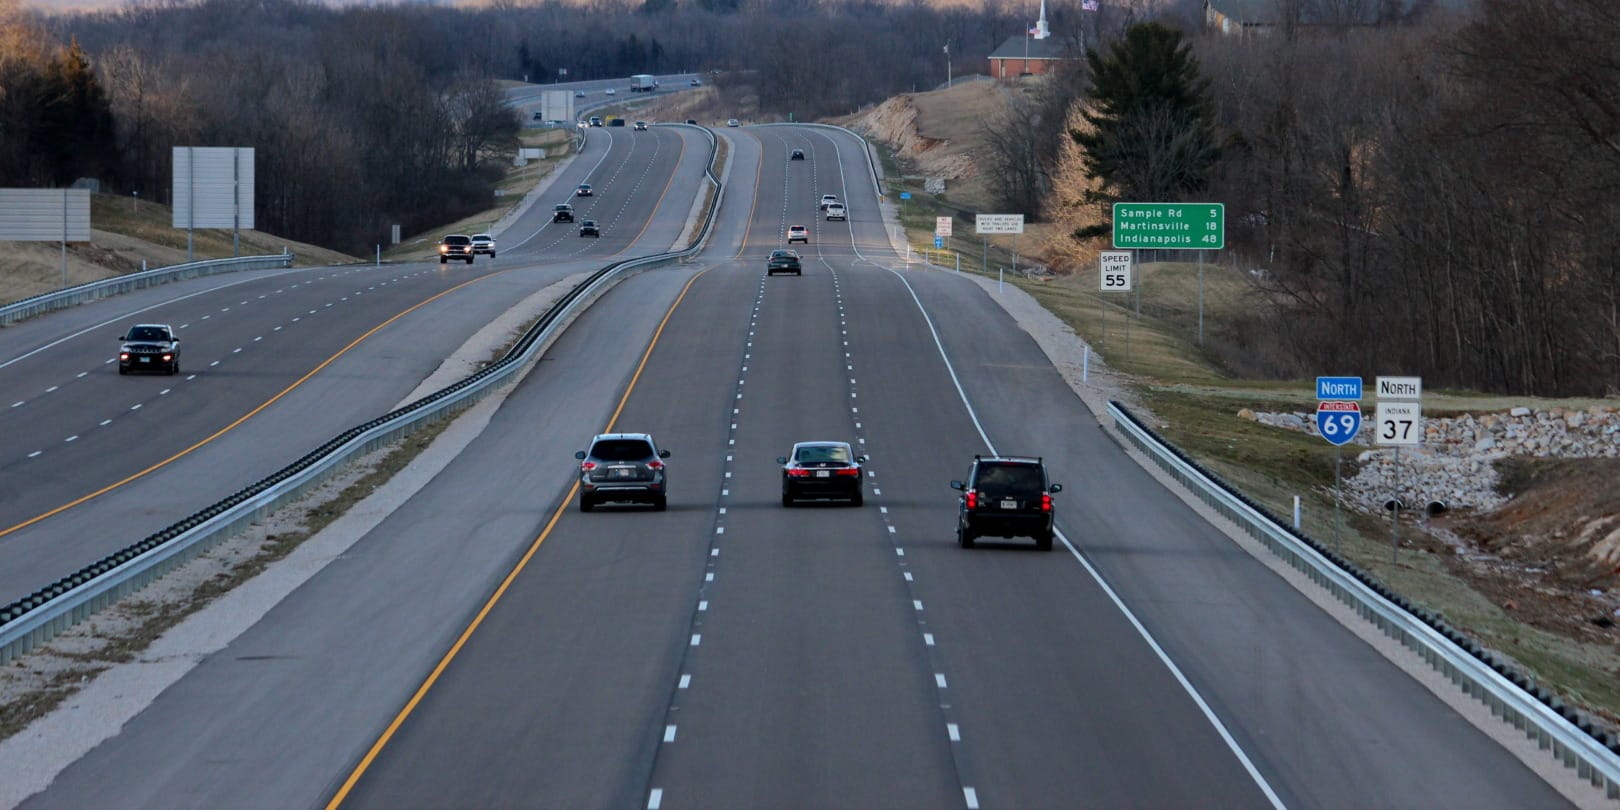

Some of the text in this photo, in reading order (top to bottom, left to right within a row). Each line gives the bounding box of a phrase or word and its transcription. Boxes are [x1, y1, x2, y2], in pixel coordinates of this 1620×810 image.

[1121, 209, 1217, 219] Sample Rd 5
[1120, 221, 1217, 231] Martinsville 18
[1120, 234, 1217, 245] Indianapolis 48
[1102, 255, 1130, 263] SPEED
[1105, 274, 1126, 287] 55
[1321, 381, 1357, 396] NORTH
[1381, 380, 1416, 395] NORTH
[1385, 407, 1411, 415] INDIANA
[1323, 415, 1355, 435] 69
[1383, 419, 1413, 440] 37
